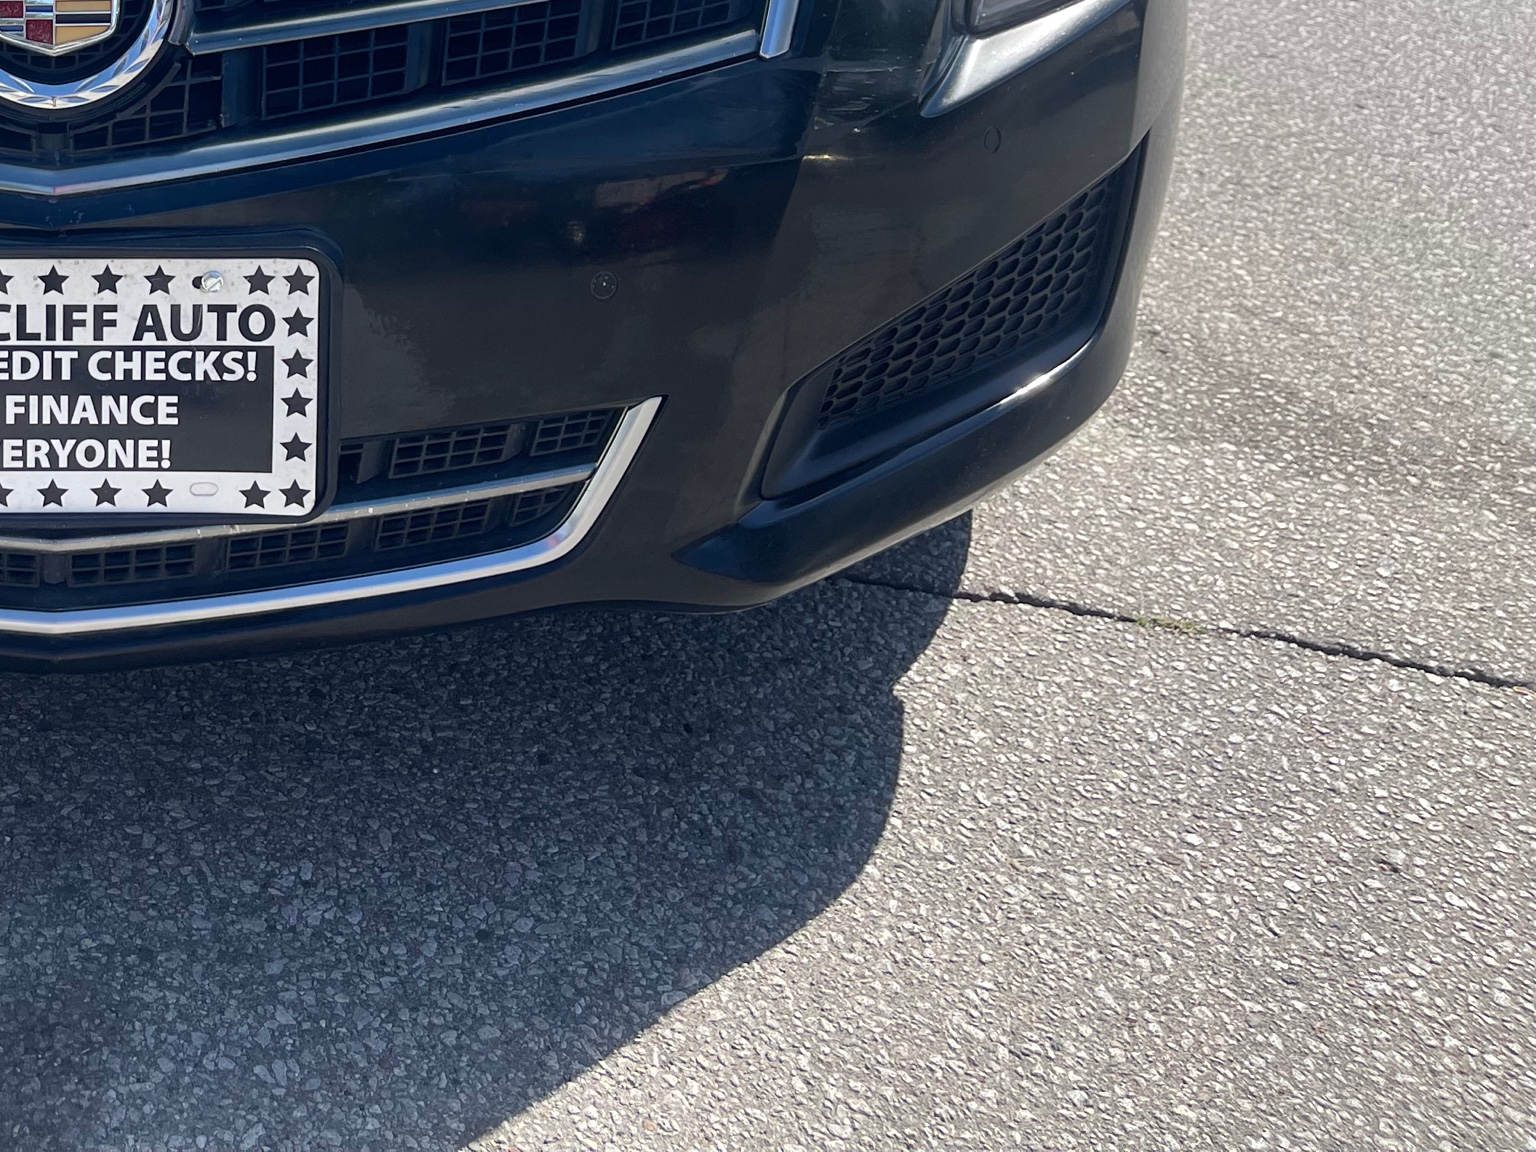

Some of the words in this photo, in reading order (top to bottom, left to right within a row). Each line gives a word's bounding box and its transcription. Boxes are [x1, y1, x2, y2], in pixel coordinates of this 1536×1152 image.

[131, 303, 277, 342] AUTO
[86, 349, 258, 382] CHECKS!
[4, 394, 180, 426] FINANCE
